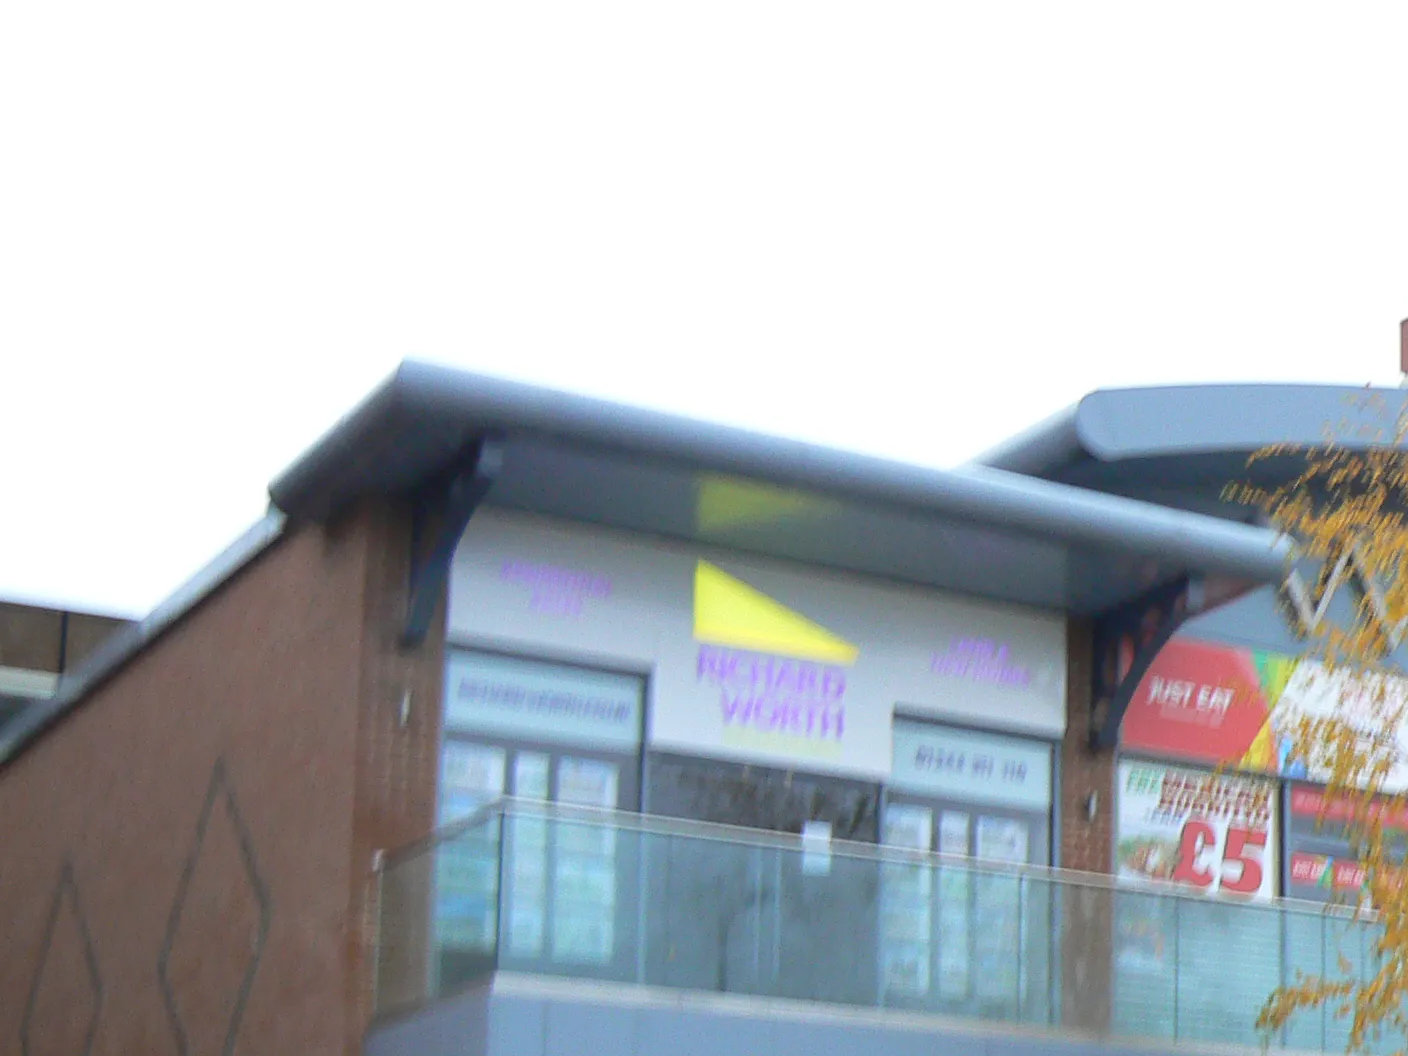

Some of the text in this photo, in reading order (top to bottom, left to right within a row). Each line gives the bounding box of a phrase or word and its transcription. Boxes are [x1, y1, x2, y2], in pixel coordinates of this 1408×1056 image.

[1147, 676, 1235, 716] JUST EAT
[1171, 819, 1268, 892] £5
